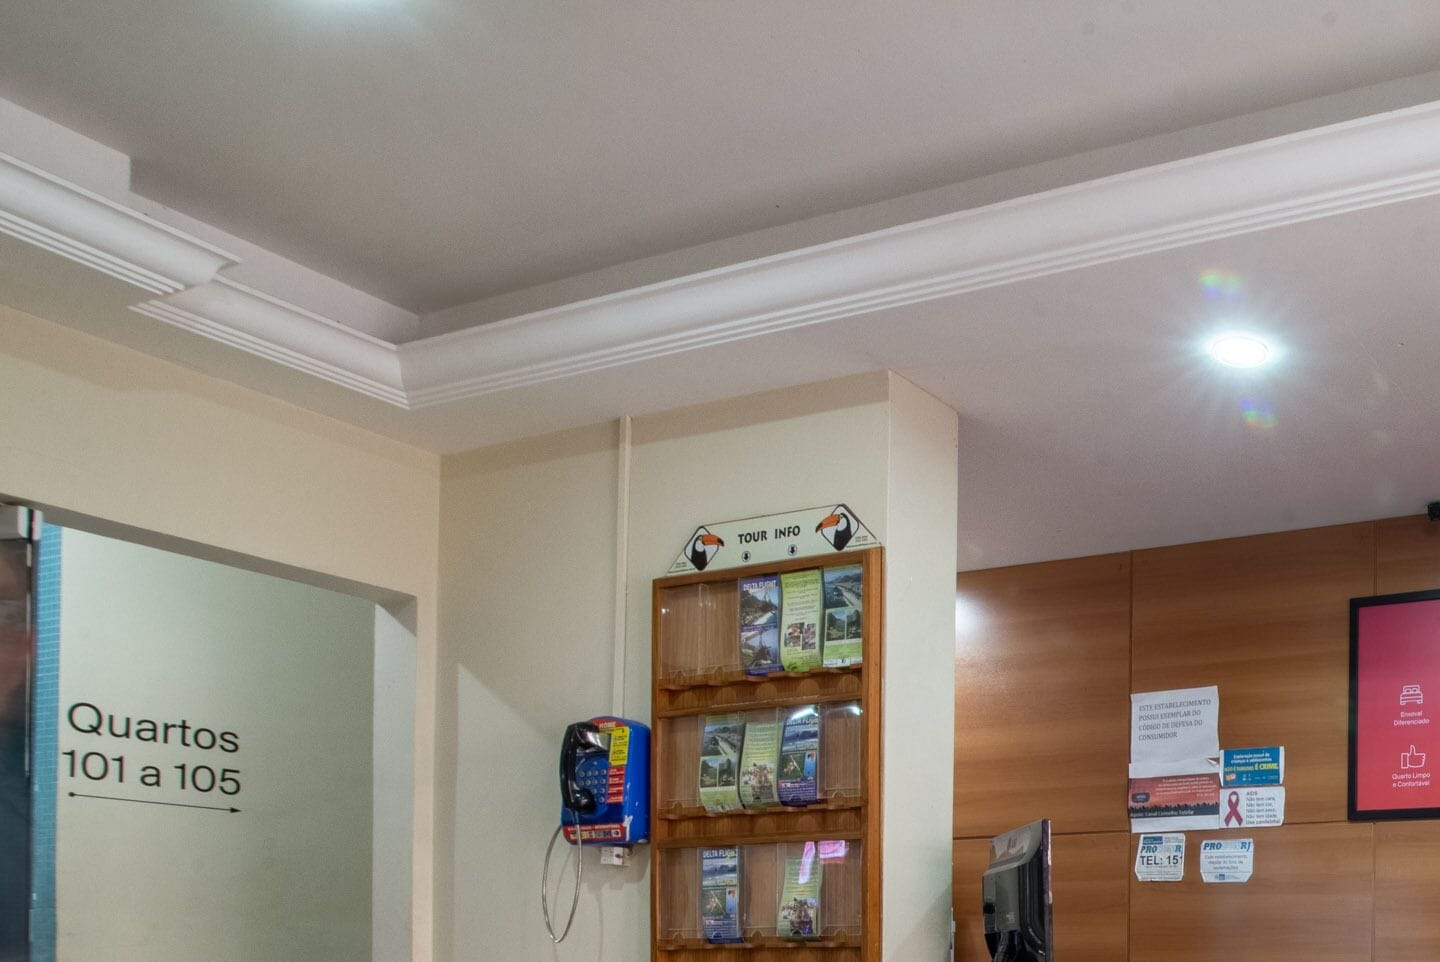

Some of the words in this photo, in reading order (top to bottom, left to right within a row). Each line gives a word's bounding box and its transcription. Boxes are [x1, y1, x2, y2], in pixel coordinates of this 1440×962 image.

[738, 531, 767, 544] TOUR
[774, 525, 801, 539] INFO
[743, 582, 759, 591] DELTA
[1154, 699, 1212, 710] ESTABELECIMENTO
[1160, 711, 1191, 720] EXEMPLAR
[1139, 722, 1160, 731] CÓDIGO
[1171, 720, 1192, 728] DEFESA
[1393, 718, 1430, 726] Diferenciado
[67, 702, 240, 753] Quartos
[1139, 731, 1178, 741] CONSUMIDOR
[61, 750, 125, 783] 101
[140, 765, 161, 788] a
[174, 763, 242, 795] 105
[1392, 772, 1411, 780] Quarto
[1412, 771, 1430, 780] Limpo
[1397, 780, 1430, 788] Confortável
[1141, 845, 1158, 853] PRO
[1203, 842, 1222, 850] PRO
[1240, 841, 1251, 852] RJ
[703, 849, 719, 858] DELTA
[1140, 855, 1163, 865] TEL:
